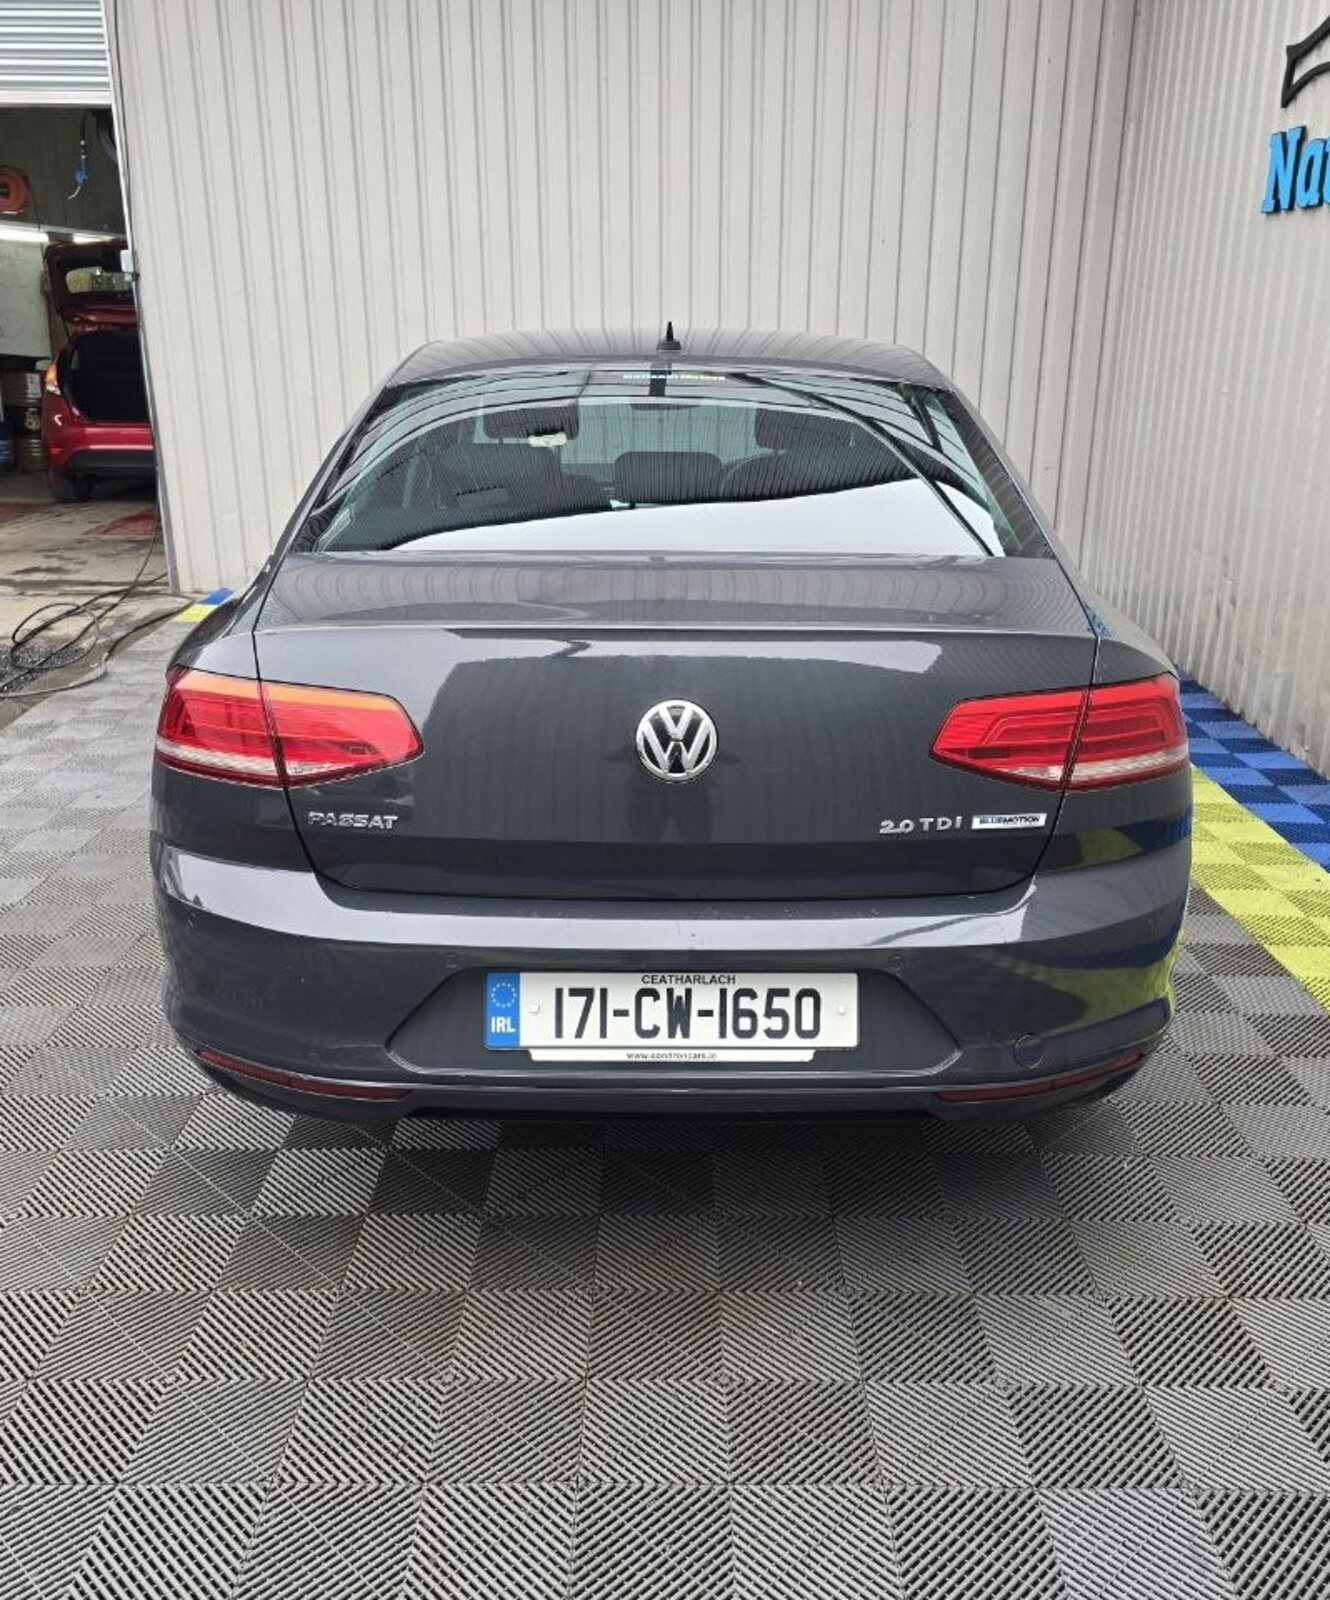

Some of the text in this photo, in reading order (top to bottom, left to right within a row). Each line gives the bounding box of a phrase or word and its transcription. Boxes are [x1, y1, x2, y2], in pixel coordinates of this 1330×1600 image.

[1261, 126, 1330, 213] Na
[308, 811, 398, 829] PASSAT
[641, 974, 736, 985] CEATHARLACH
[554, 987, 821, 1039] 171-CW-1650
[490, 1017, 516, 1034] IRL
